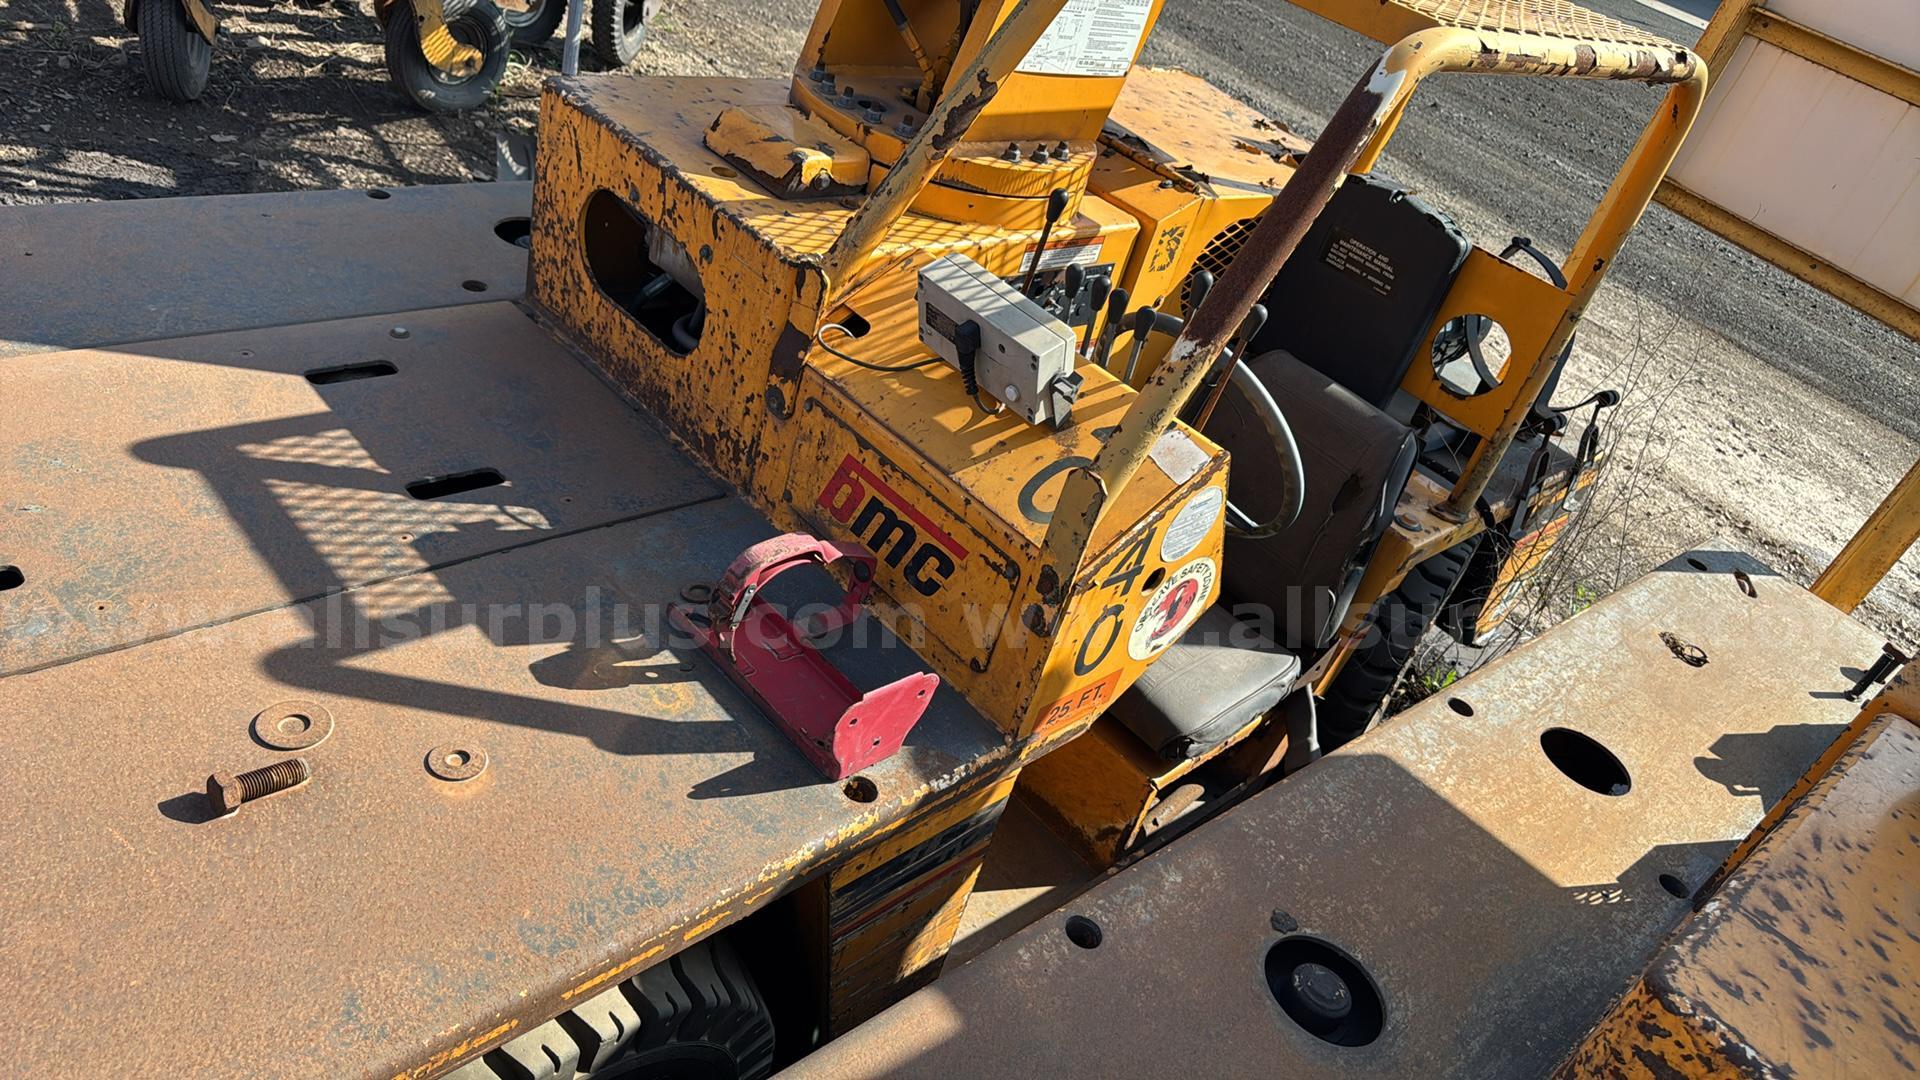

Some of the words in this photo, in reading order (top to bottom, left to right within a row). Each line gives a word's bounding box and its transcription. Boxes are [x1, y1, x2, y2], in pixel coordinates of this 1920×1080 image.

[1339, 239, 1373, 261] MAINTENANCE
[1373, 258, 1394, 273] MANUAL
[1350, 238, 1377, 256] OPERATION
[1378, 254, 1390, 263] AND
[1046, 699, 1073, 726] 25
